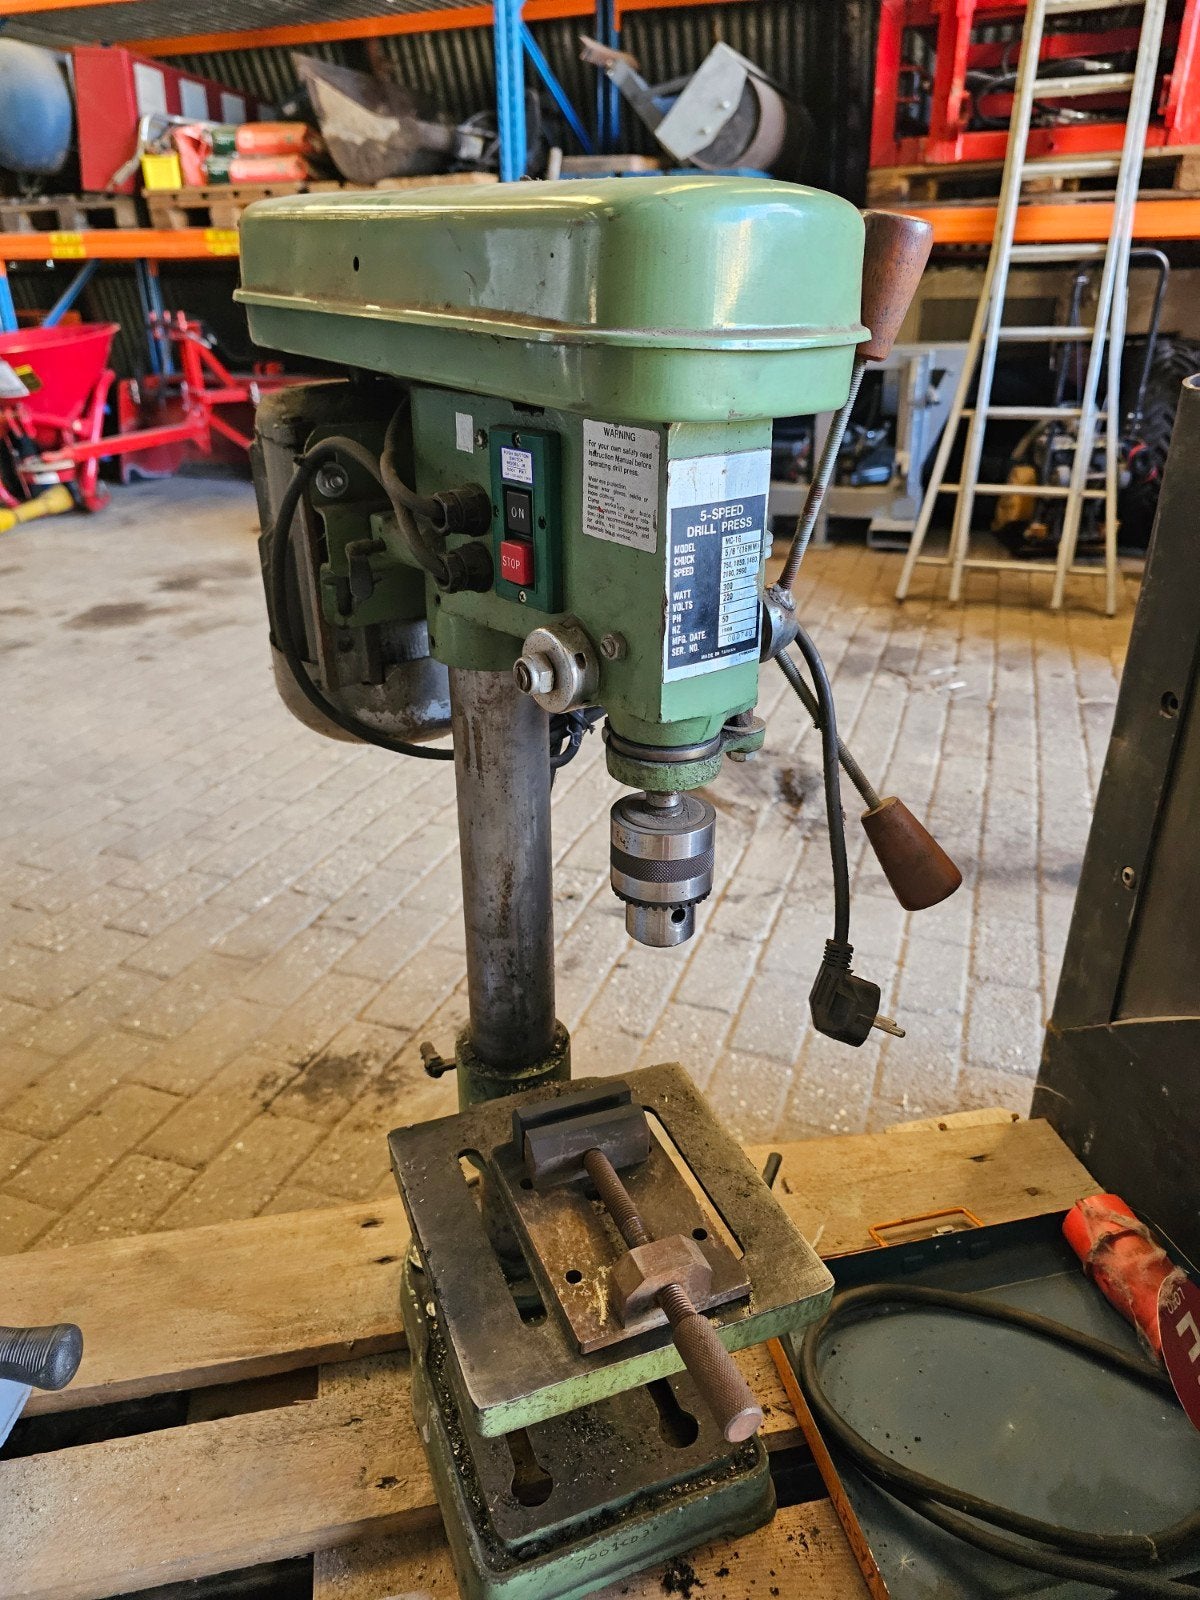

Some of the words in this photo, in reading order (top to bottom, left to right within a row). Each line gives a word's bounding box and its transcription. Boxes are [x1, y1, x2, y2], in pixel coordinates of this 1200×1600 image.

[604, 427, 636, 442] WARNING
[598, 442, 609, 450] your
[623, 448, 638, 458] safety
[640, 452, 652, 460] read
[588, 460, 611, 472] operating
[613, 464, 622, 472] drill
[615, 454, 634, 466] Manual
[634, 459, 652, 470] before
[511, 506, 524, 520] ON
[700, 504, 744, 521] 5-SPEED
[686, 524, 716, 538] DRILL
[722, 516, 752, 532] PRESS
[674, 543, 696, 555] MODEL
[502, 555, 520, 570] STOP
[674, 555, 695, 566] CHUCK
[674, 566, 694, 578] SPEED
[672, 590, 691, 600] WATT
[723, 582, 733, 591] 300
[672, 601, 693, 612] VOLTS
[723, 593, 734, 601] 220
[672, 614, 681, 624] PH
[722, 615, 729, 623] 50
[672, 635, 687, 646] MFG.
[672, 646, 686, 657] SER.
[689, 644, 700, 653] NO.
